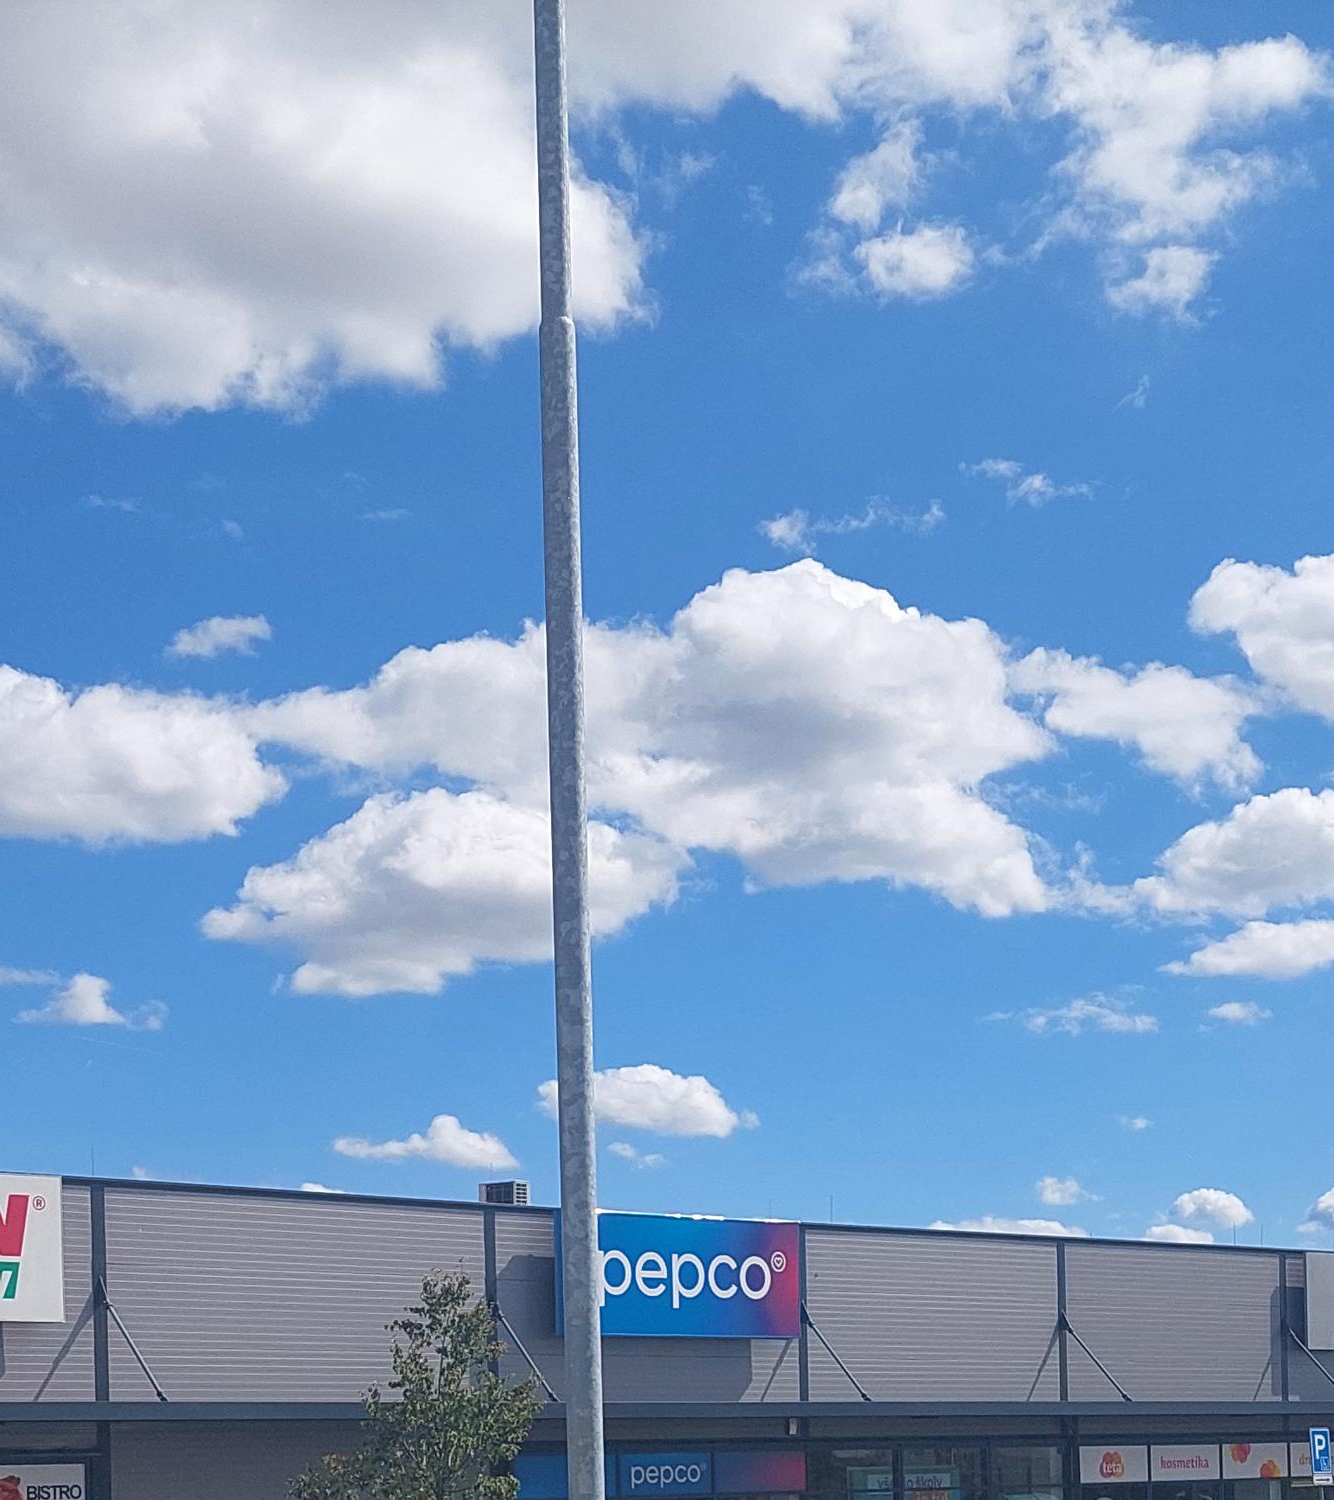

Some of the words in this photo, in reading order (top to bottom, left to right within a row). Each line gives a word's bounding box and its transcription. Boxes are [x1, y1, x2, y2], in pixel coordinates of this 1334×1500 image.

[597, 1250, 772, 1309] pepco
[1316, 1434, 1326, 1460] P
[1102, 1460, 1122, 1474] teta
[1160, 1455, 1210, 1470] kosmetika
[630, 1463, 702, 1489] pepco
[26, 1484, 82, 1500] BISTRO
